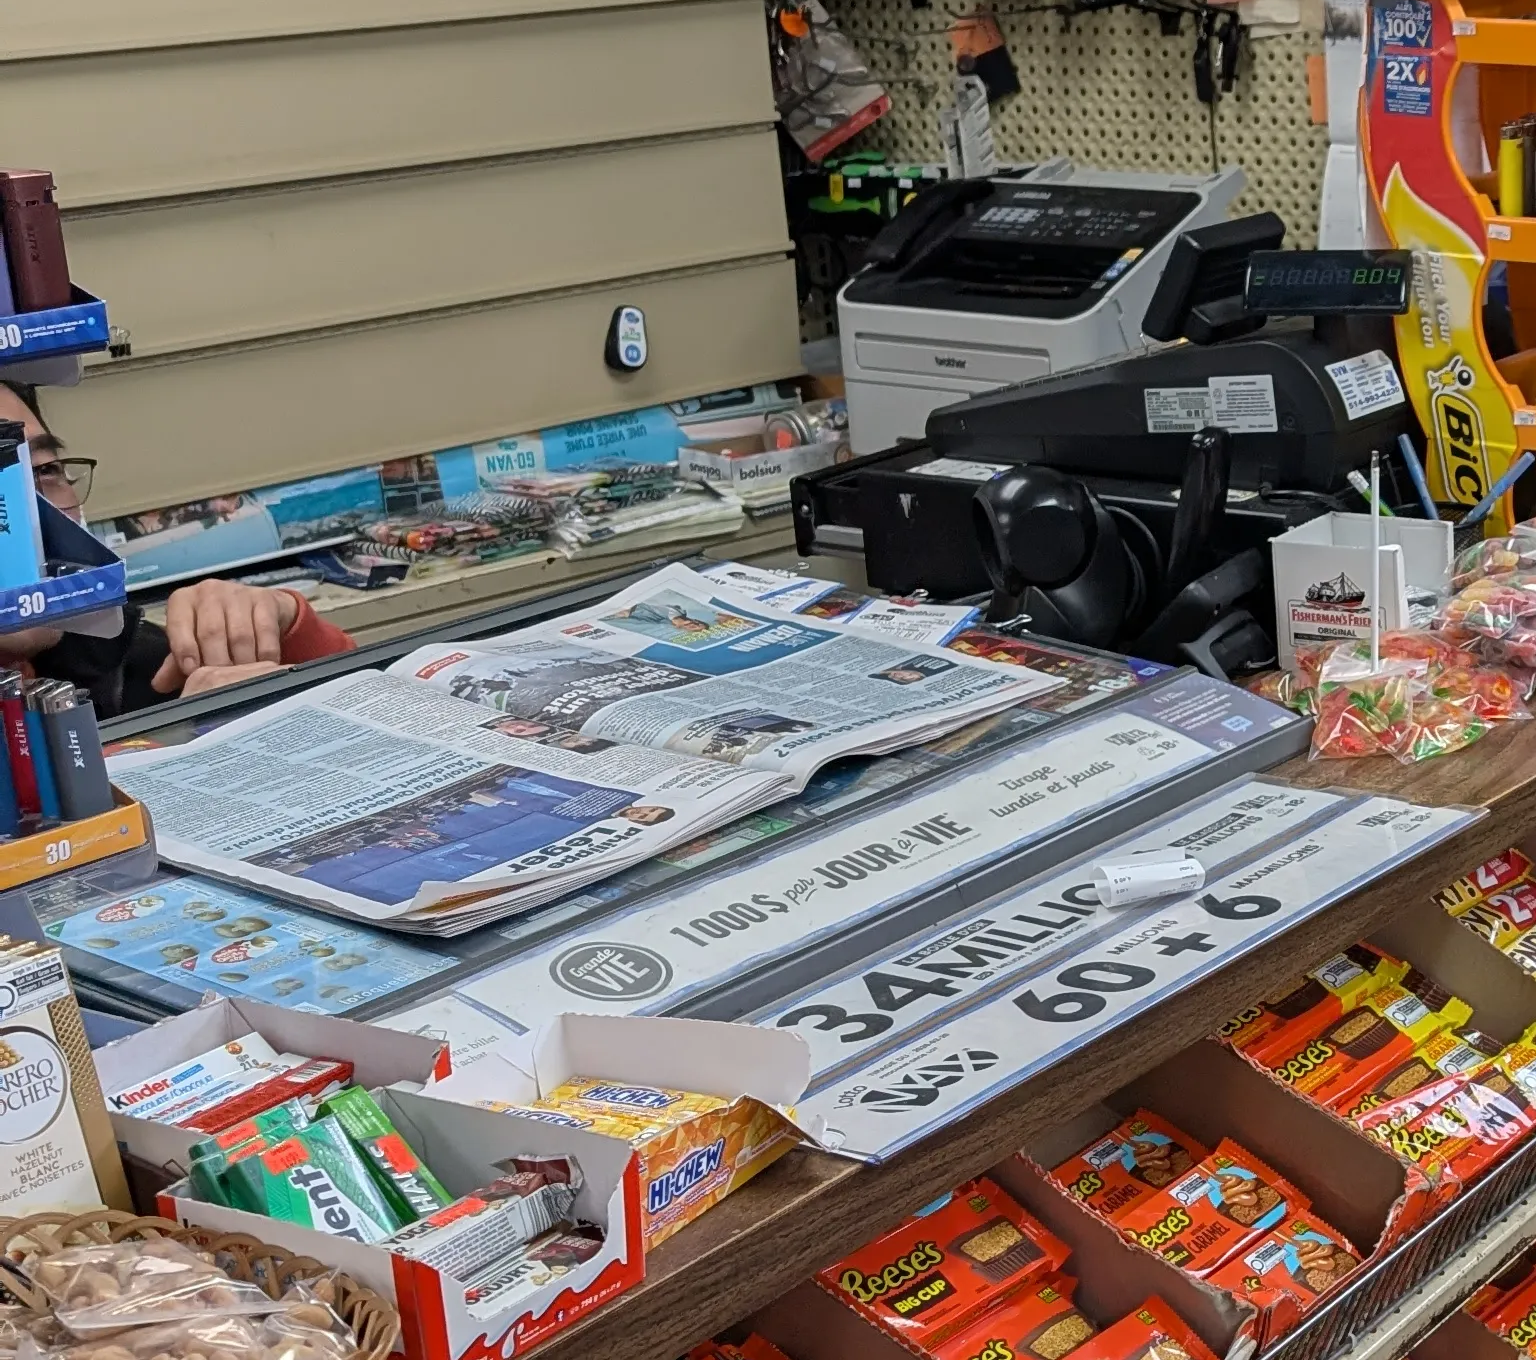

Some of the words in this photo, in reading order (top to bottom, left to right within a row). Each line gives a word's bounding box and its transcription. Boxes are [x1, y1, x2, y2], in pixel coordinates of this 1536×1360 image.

[18, 591, 46, 617] 30
[1291, 608, 1348, 625] FISHERMAN'S
[1317, 626, 1358, 638] ORIGINAL
[988, 790, 1046, 819] lundis
[1049, 784, 1067, 798] et
[1067, 757, 1117, 789] jeudis
[999, 763, 1057, 792] Tirage
[45, 839, 72, 865] 30
[546, 827, 641, 870] Philippe
[782, 876, 816, 906] par
[822, 836, 910, 890] JOUR
[909, 811, 974, 849] VIE
[1233, 843, 1319, 890] MAXMILLIONS
[1105, 917, 1179, 957] MILLIONS
[569, 948, 616, 979] Grande
[581, 953, 651, 994] VIE
[1011, 960, 1157, 1024] 60
[1195, 893, 1283, 922] 6
[776, 971, 963, 1044] 34
[108, 1075, 174, 1111] Kinder
[575, 1083, 680, 1109] HI-CHEW
[833, 1084, 869, 1110] Lotto
[1390, 1103, 1469, 1162] Reese's
[10, 1146, 64, 1178] HAZELNUT
[15, 1141, 53, 1164] WHITE
[20, 1158, 61, 1184] BLANC
[29, 1159, 85, 1189] NOISETTES
[646, 1138, 726, 1215] HI-CHEW
[841, 1240, 943, 1305] Reese's
[894, 1290, 922, 1316] BIG
[917, 1276, 948, 1302] CUP
